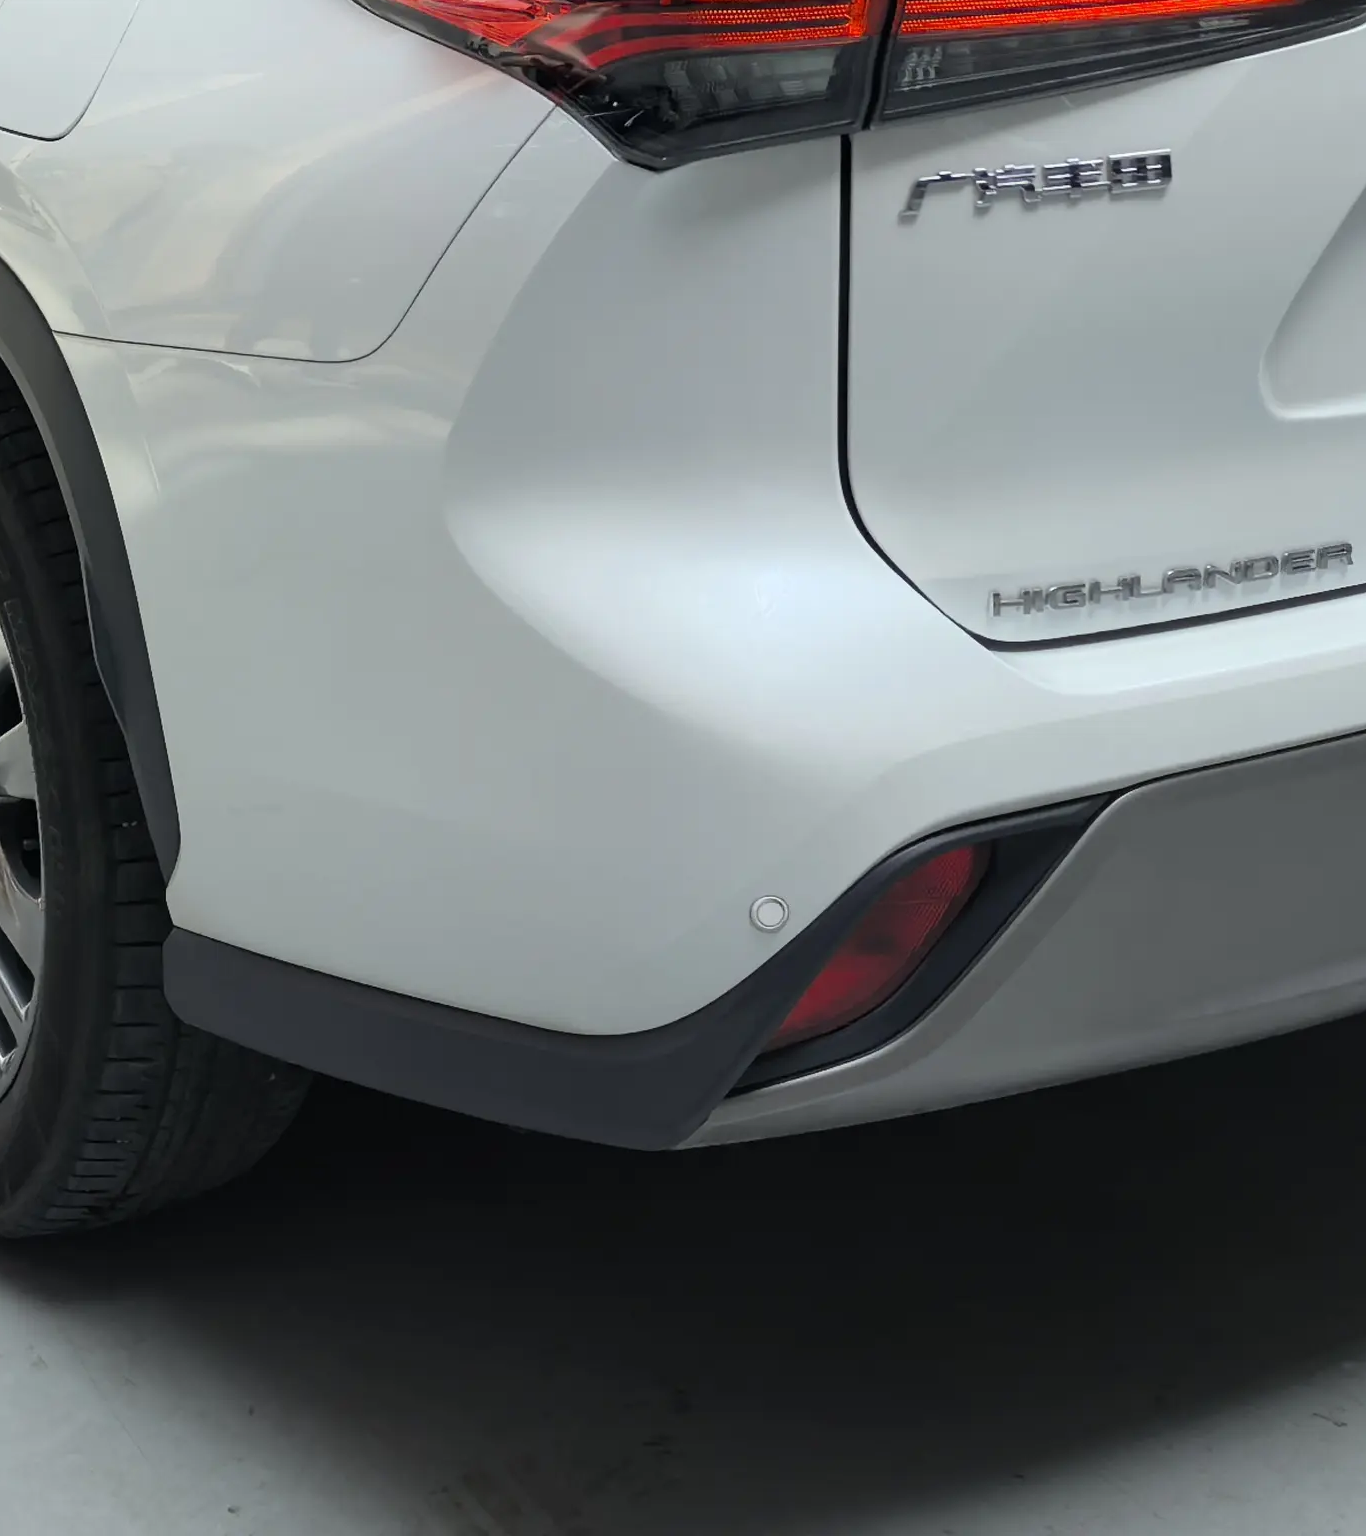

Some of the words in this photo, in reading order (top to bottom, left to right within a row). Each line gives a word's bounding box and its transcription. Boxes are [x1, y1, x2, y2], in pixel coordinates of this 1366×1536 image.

[898, 148, 1173, 220] 广汽丰田
[988, 541, 1355, 618] HIGHLANDER
